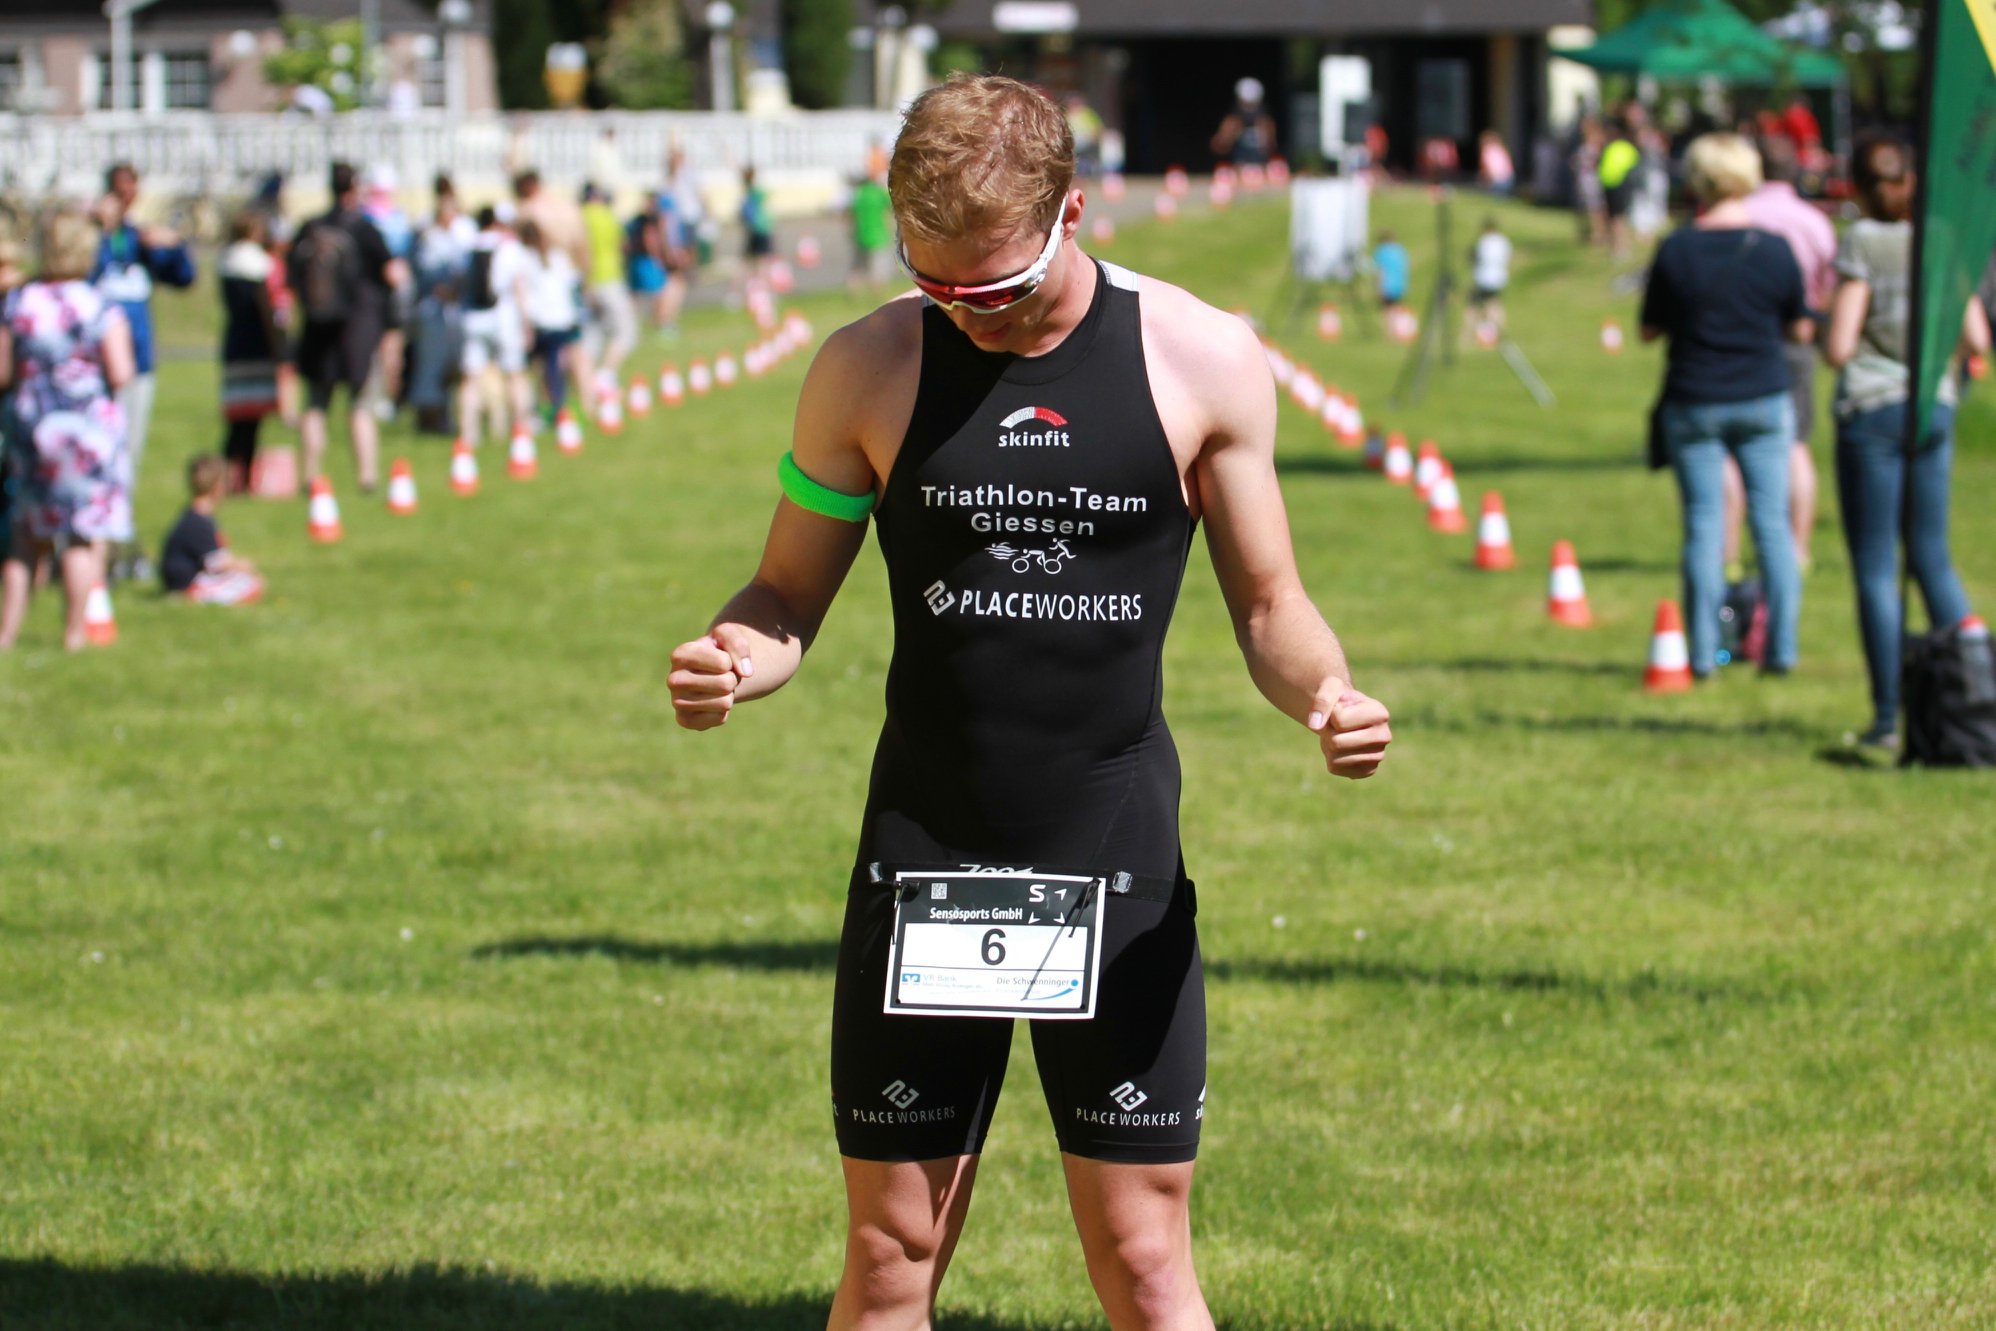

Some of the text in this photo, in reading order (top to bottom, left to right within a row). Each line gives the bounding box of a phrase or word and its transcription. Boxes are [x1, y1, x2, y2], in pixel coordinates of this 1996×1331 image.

[998, 430, 1070, 447] skinfit
[921, 484, 1147, 512] Triathlon-Team
[971, 512, 1095, 536] Giessen
[959, 589, 1142, 621] PLACEWORKERS
[991, 907, 1023, 920] GmbH
[980, 928, 1006, 966] 6
[996, 977, 1010, 985] Die
